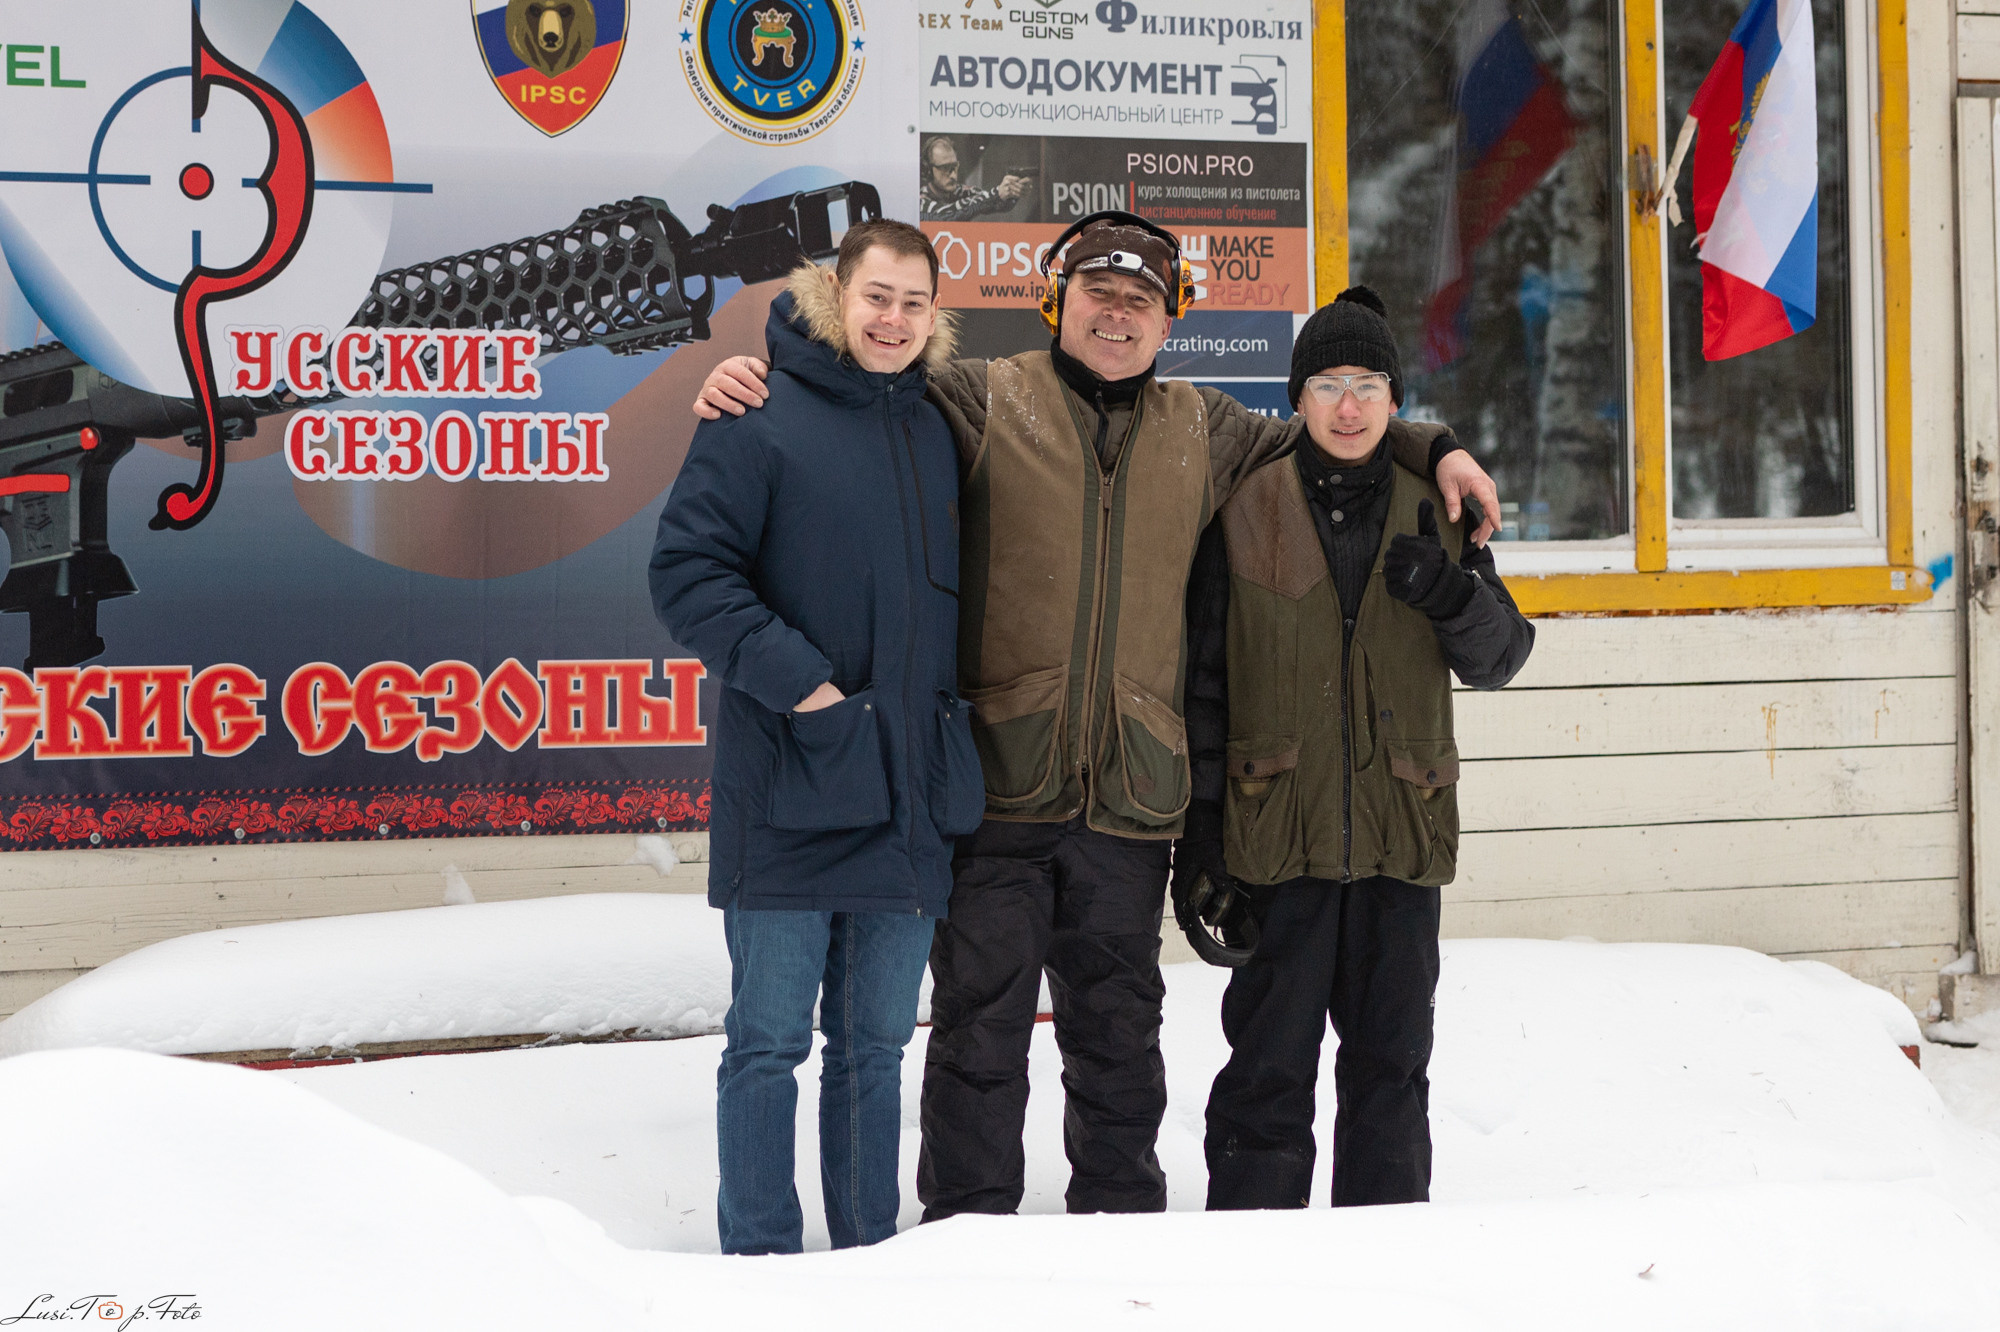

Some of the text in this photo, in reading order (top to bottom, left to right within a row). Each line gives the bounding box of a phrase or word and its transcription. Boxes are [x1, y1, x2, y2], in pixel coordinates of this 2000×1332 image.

[960, 14, 1004, 31] Team
[1009, 9, 1089, 26] CUSTOM
[1095, 0, 1303, 45] Филикровля
[1022, 25, 1074, 40] GUNS
[0, 44, 86, 88] EL
[929, 54, 1224, 97] АВТОДОКУМЕНТ
[521, 85, 587, 105] IPSC
[733, 74, 816, 107] TVER
[711, 104, 767, 141] практической
[768, 125, 809, 143] стрельбы
[808, 98, 843, 131] Тверской
[929, 100, 1224, 126] МНОГОФУНКЦИОНАЛЬНЫЙ ЦЕНТР
[1127, 152, 1255, 177] PSION.PRO
[1052, 181, 1125, 216] PSION
[1137, 185, 1301, 201] курс холощения из пистолета
[1138, 203, 1277, 222] дистанционное обучение
[1208, 235, 1274, 258] MAKE
[1210, 258, 1261, 281] YOU
[1209, 282, 1290, 306] READY
[288, 414, 605, 477] СЕЗОНЫ
[281, 657, 706, 762] СЕЗОНЫ
